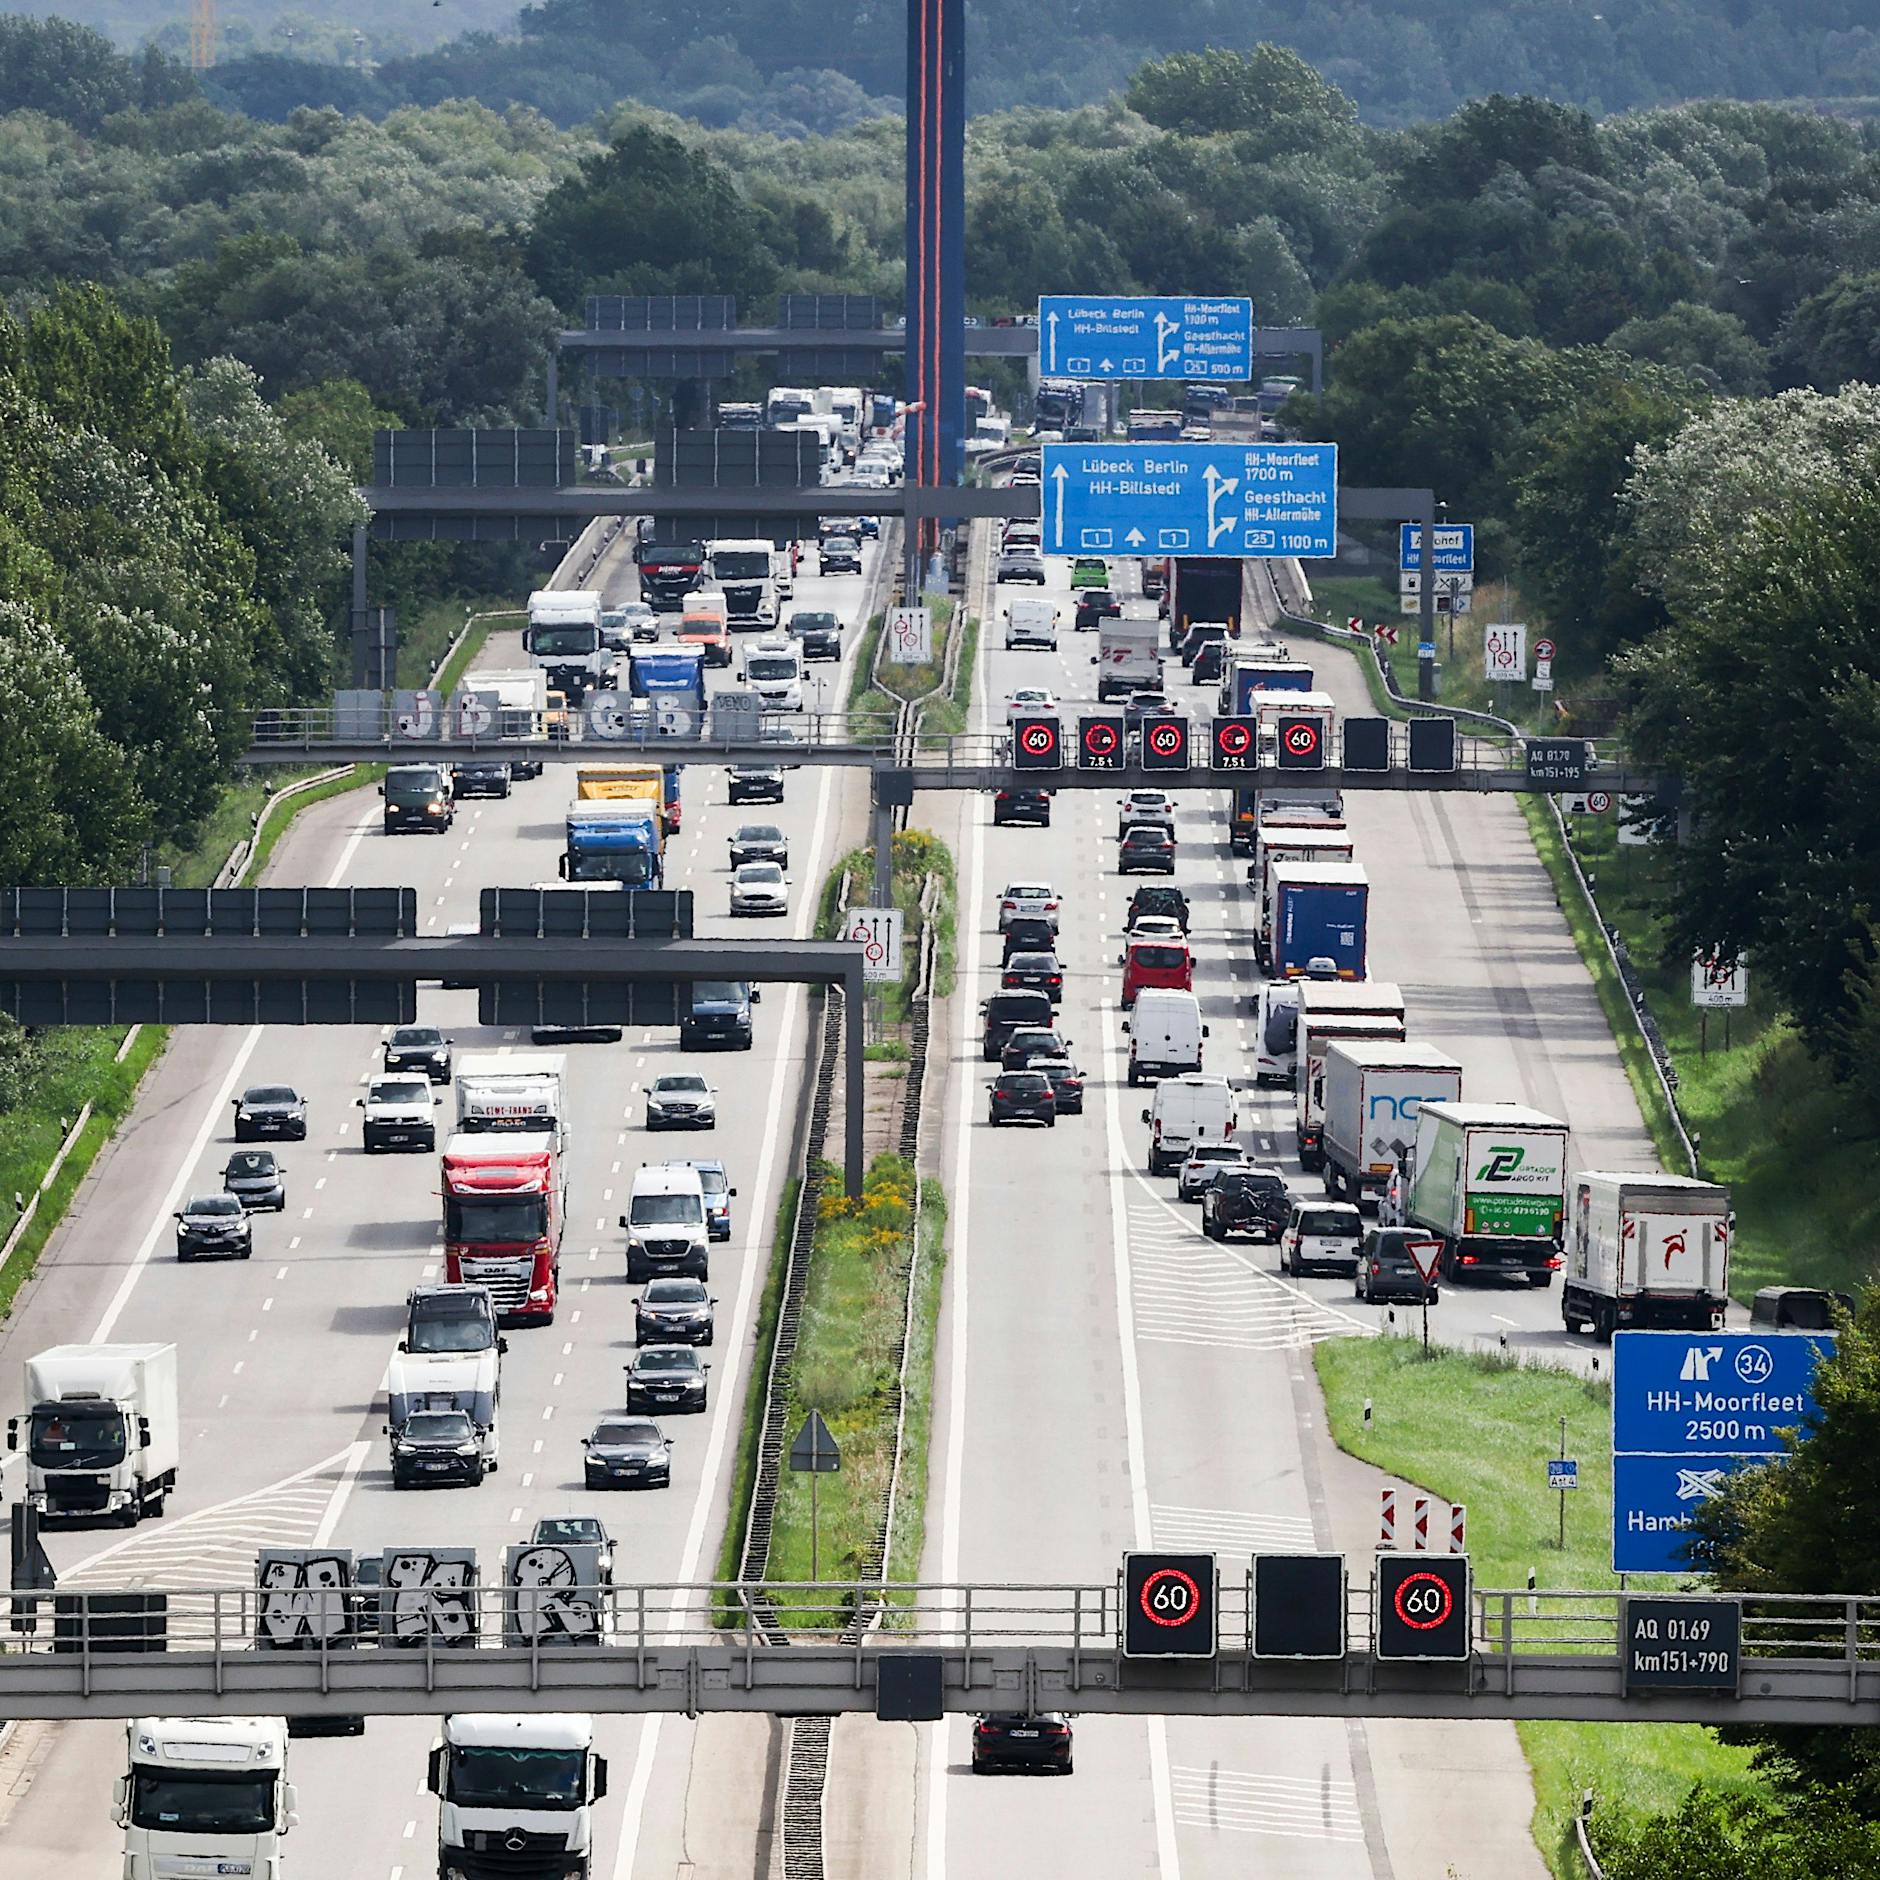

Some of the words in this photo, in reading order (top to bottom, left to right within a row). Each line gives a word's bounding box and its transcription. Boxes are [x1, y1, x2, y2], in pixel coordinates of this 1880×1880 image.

[1068, 308, 1107, 319] Lübeck
[1112, 308, 1145, 319] Berlin
[1184, 303, 1240, 314] HH-Moorfleet
[1207, 316, 1219, 325] m
[1074, 323, 1139, 334] HH-Billstedt
[1184, 330, 1246, 341] Geesthacht
[1211, 363, 1231, 375] 500
[1231, 365, 1243, 374] m
[1244, 452, 1320, 466] HH-Moorfleet
[1082, 459, 1135, 473] Lübeck
[1144, 459, 1189, 474] Berlin
[1245, 467, 1277, 481] 1700
[1279, 470, 1294, 481] m
[1089, 481, 1181, 495] HH-Billstedt
[1244, 490, 1327, 504] Geesthacht
[1244, 507, 1322, 522] HH-Allermöhe
[1251, 534, 1267, 545] 25
[1281, 535, 1312, 549] 1100
[1314, 538, 1328, 549] m
[1028, 732, 1048, 747] 60
[1156, 732, 1175, 747] 60
[1291, 732, 1311, 747] 60
[1106, 756, 1113, 767] t
[1239, 756, 1246, 767] t
[1530, 750, 1544, 762] AQ
[1593, 795, 1606, 807] 60
[1740, 1354, 1767, 1375] 34
[1647, 1391, 1804, 1412] HH-Moorfleet
[1685, 1420, 1740, 1440] 2500
[1744, 1424, 1766, 1440] m
[1153, 1584, 1188, 1611] 60
[1406, 1588, 1441, 1614] 60
[1634, 1618, 1659, 1640] AQ
[1667, 1619, 1711, 1640] 01.69
[1634, 1650, 1729, 1673] km151+790
